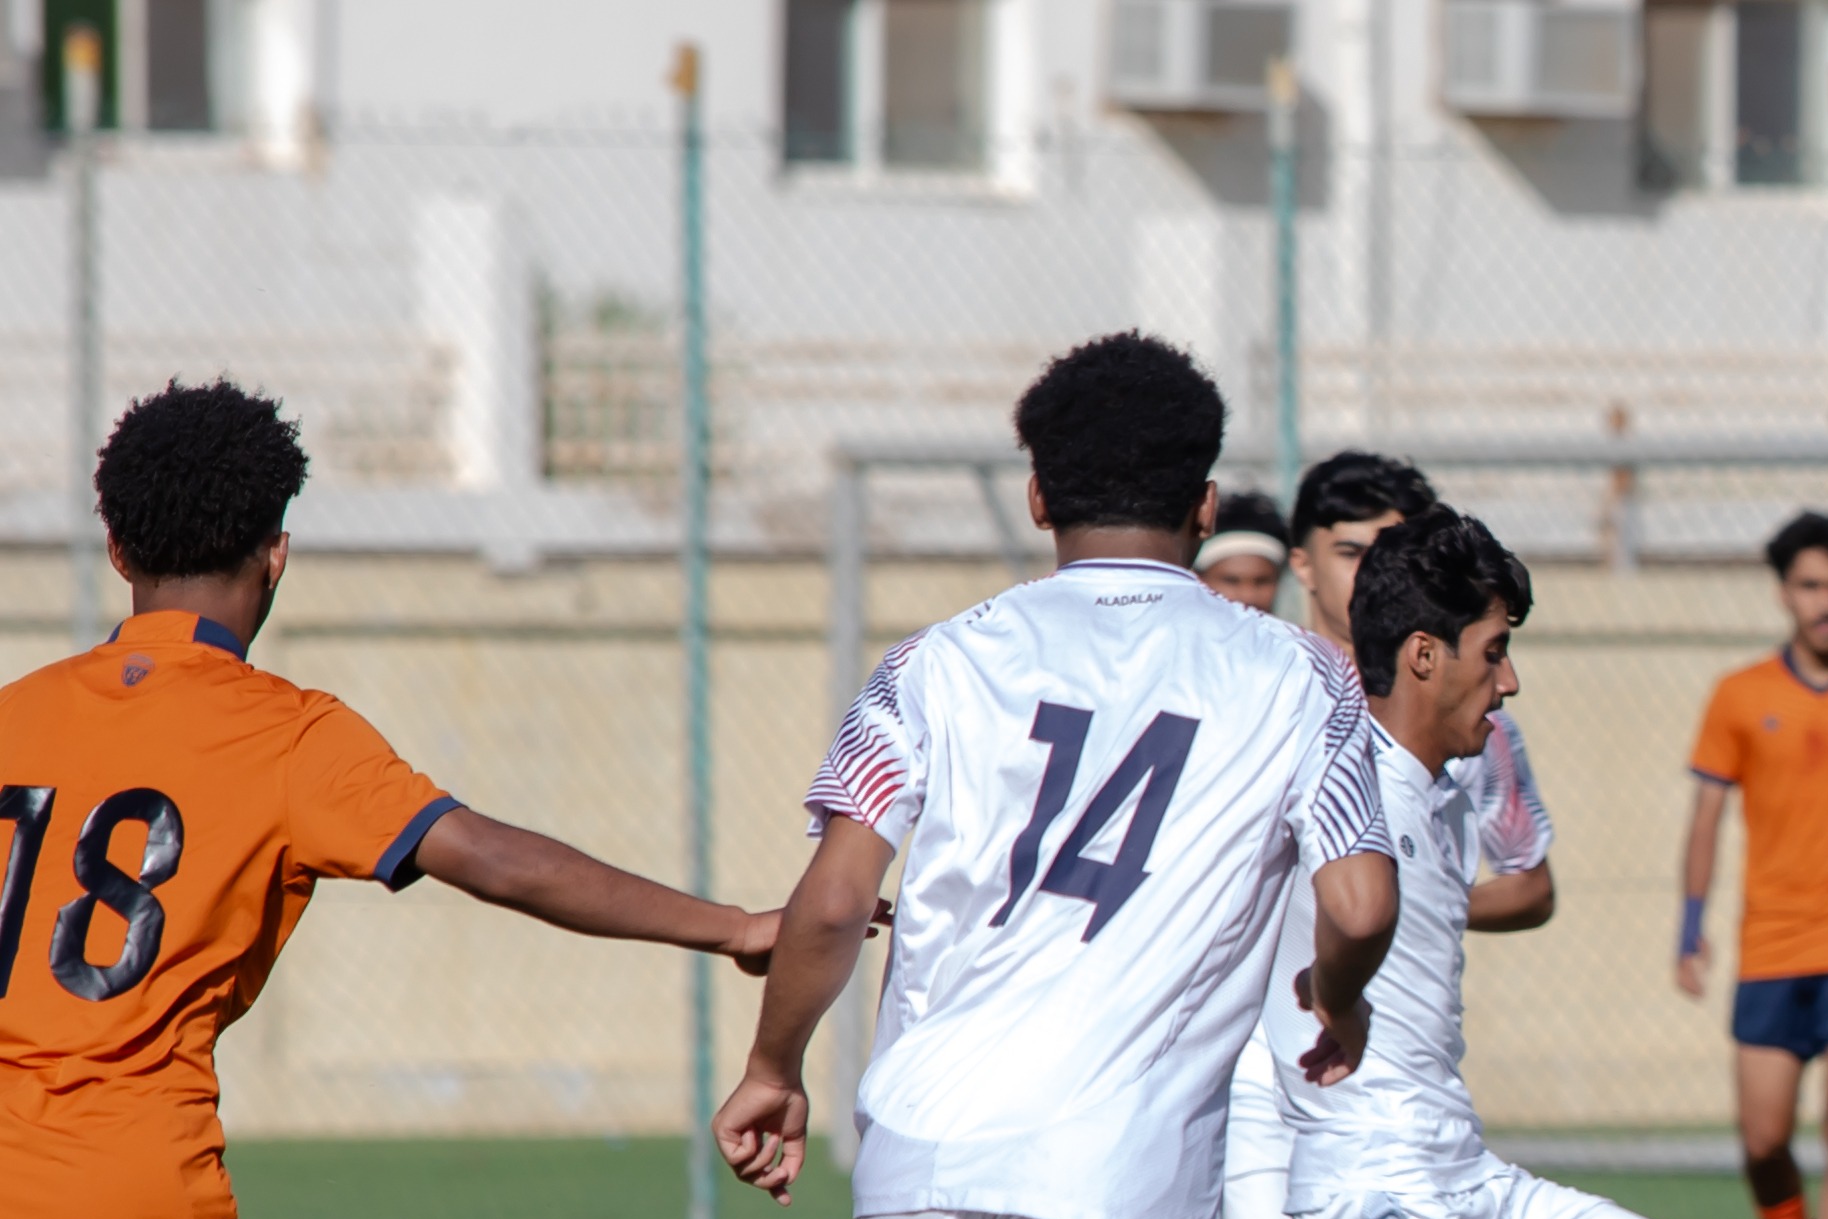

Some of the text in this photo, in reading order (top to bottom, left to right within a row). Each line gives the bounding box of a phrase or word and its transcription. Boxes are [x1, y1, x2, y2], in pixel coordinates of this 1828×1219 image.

[1094, 593, 1164, 607] ALADALAH
[0, 784, 185, 1002] 18
[987, 700, 1202, 944] 14
